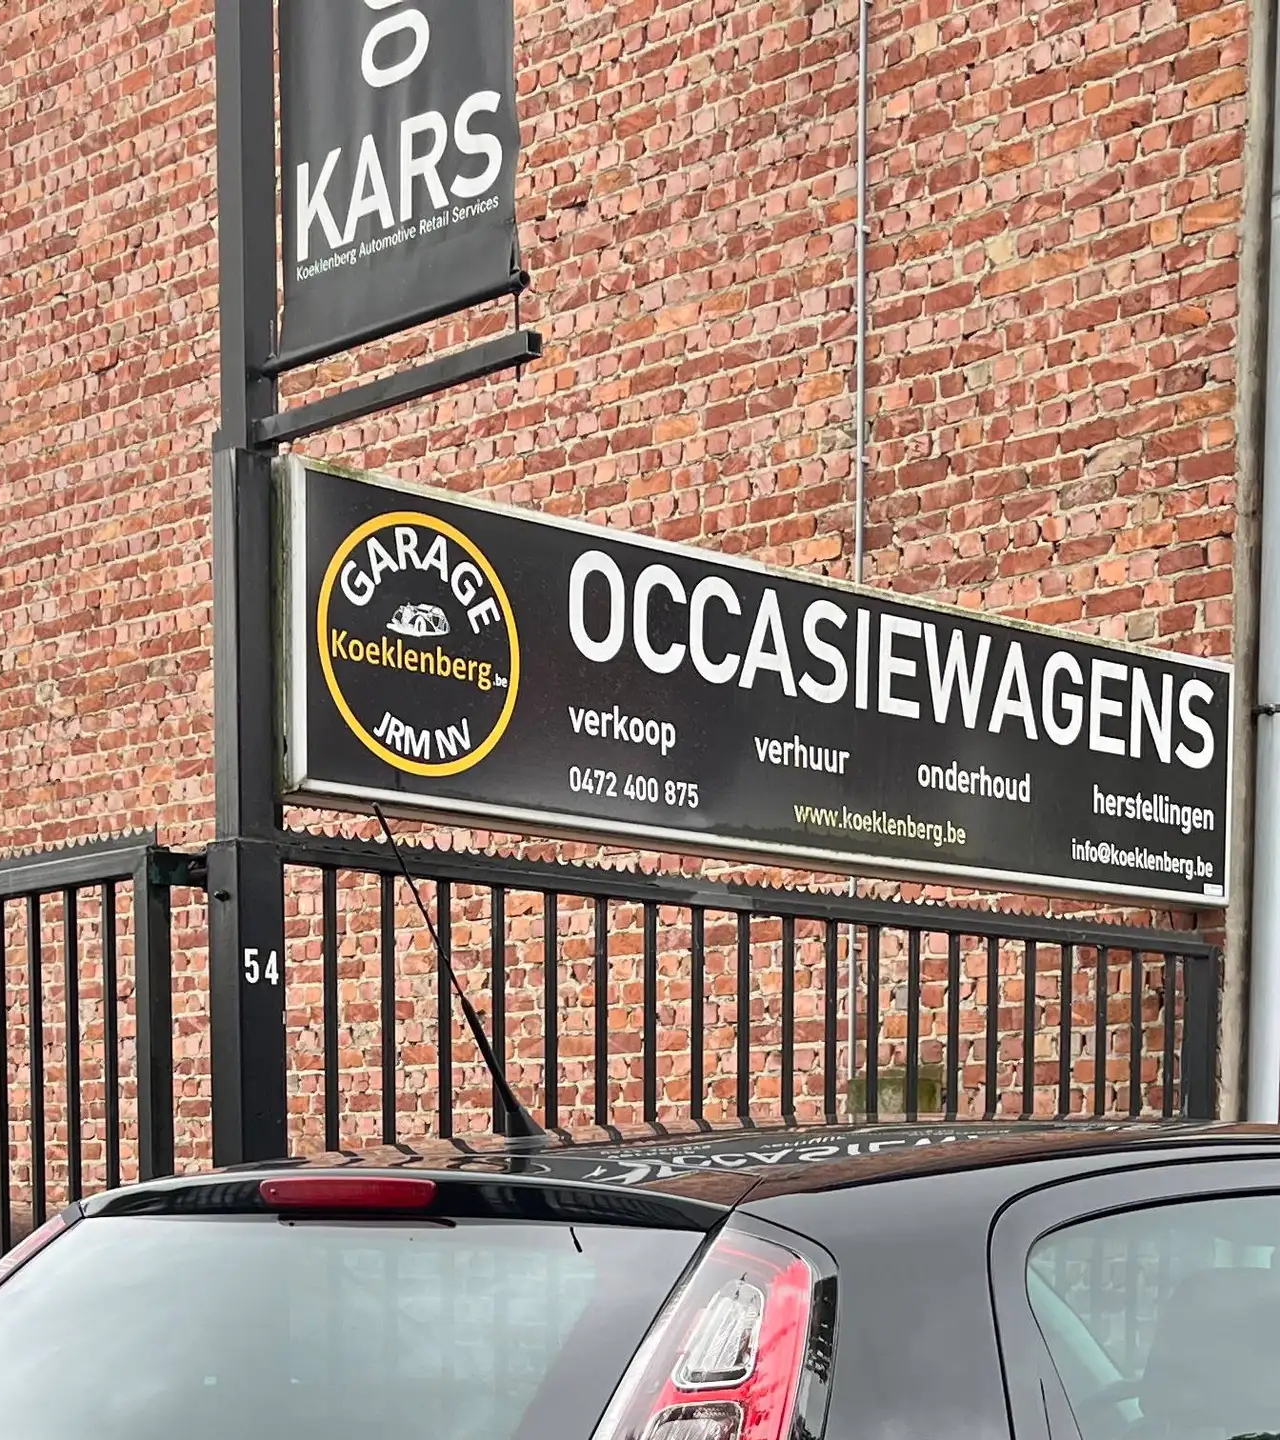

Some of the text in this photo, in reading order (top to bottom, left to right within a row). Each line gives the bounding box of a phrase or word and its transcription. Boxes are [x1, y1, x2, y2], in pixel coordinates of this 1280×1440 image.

[296, 91, 502, 262] KARS
[296, 195, 499, 282] Koeklenberg Automotive Retail Services
[340, 526, 501, 634] GARAGE
[568, 550, 1215, 769] OCCASIEWAGENS
[373, 711, 471, 760] JRM NV
[568, 705, 1215, 835] verkoop verhuur onderhoud herstellingen
[569, 766, 699, 808] 0472 400 875
[794, 803, 966, 847] www.koeklenberg.be
[1071, 838, 1213, 880] info@koeklenberg.be
[243, 948, 279, 986] 54
